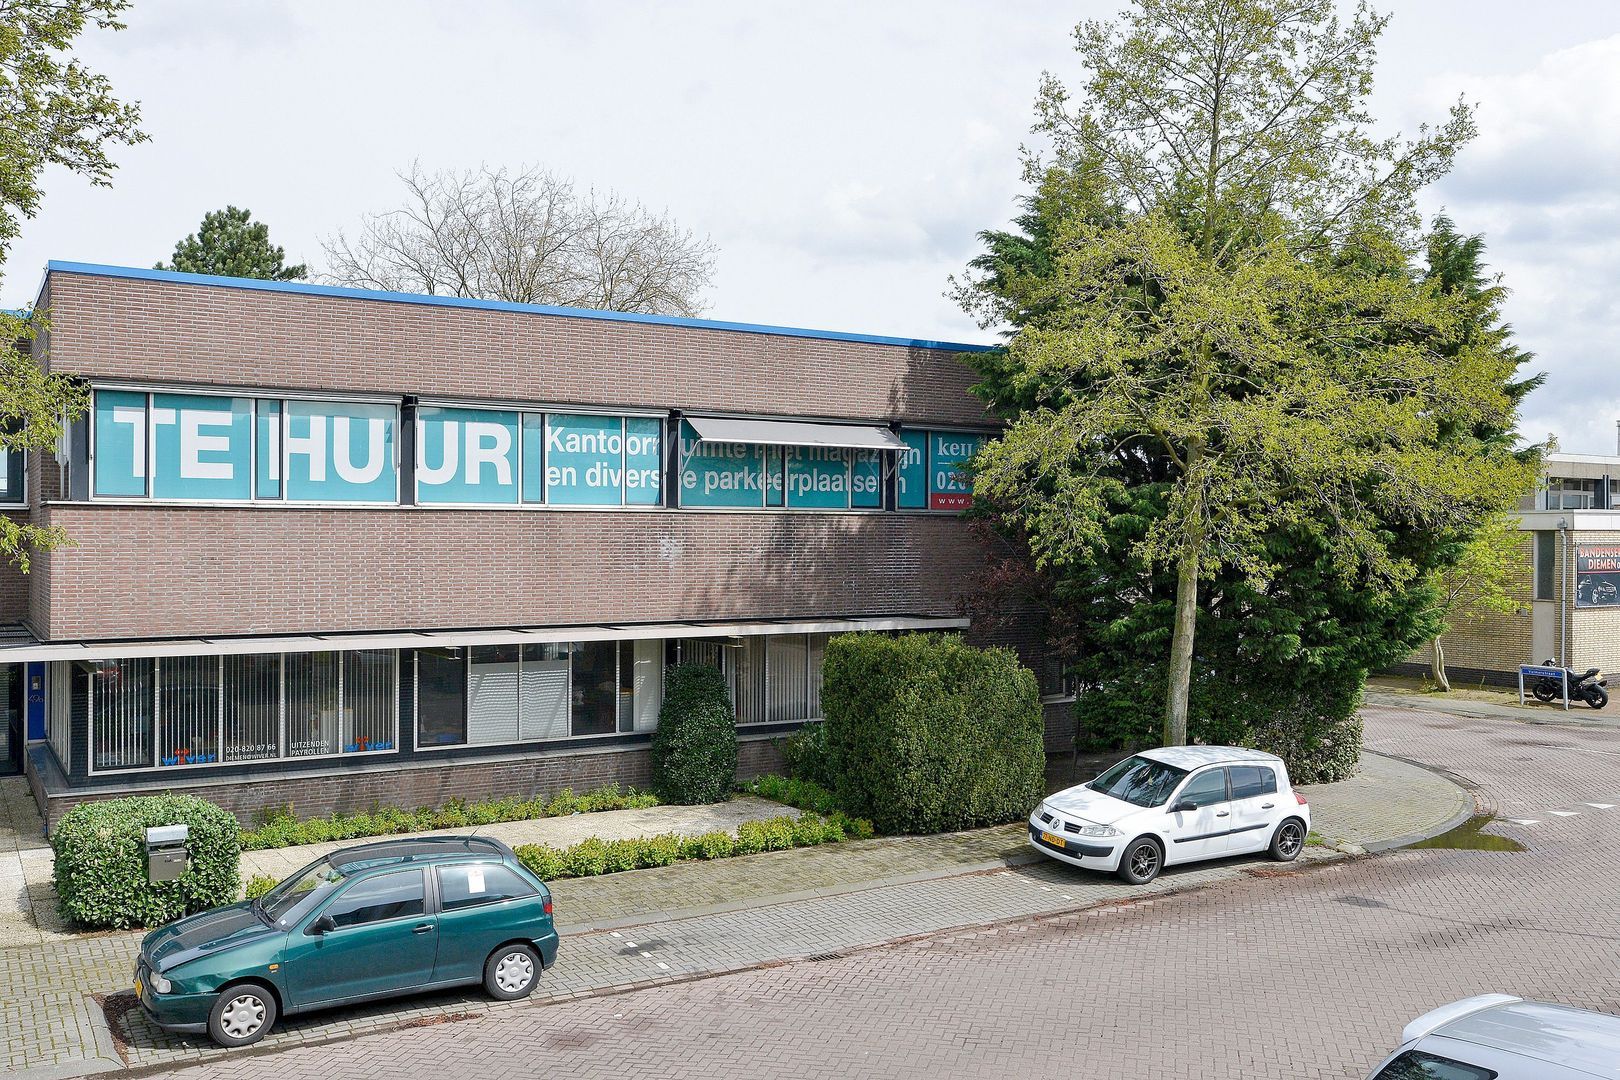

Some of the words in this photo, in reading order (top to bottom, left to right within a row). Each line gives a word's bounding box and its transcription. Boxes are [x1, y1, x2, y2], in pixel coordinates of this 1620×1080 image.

[113, 405, 234, 479] TE
[268, 413, 512, 485] HUUR
[547, 466, 577, 487] en
[1579, 547, 1620, 558] BANDENSE
[1588, 559, 1617, 570] DIEMEN
[291, 740, 330, 748] UITZENDEN
[291, 748, 330, 756] PAYROLLEN
